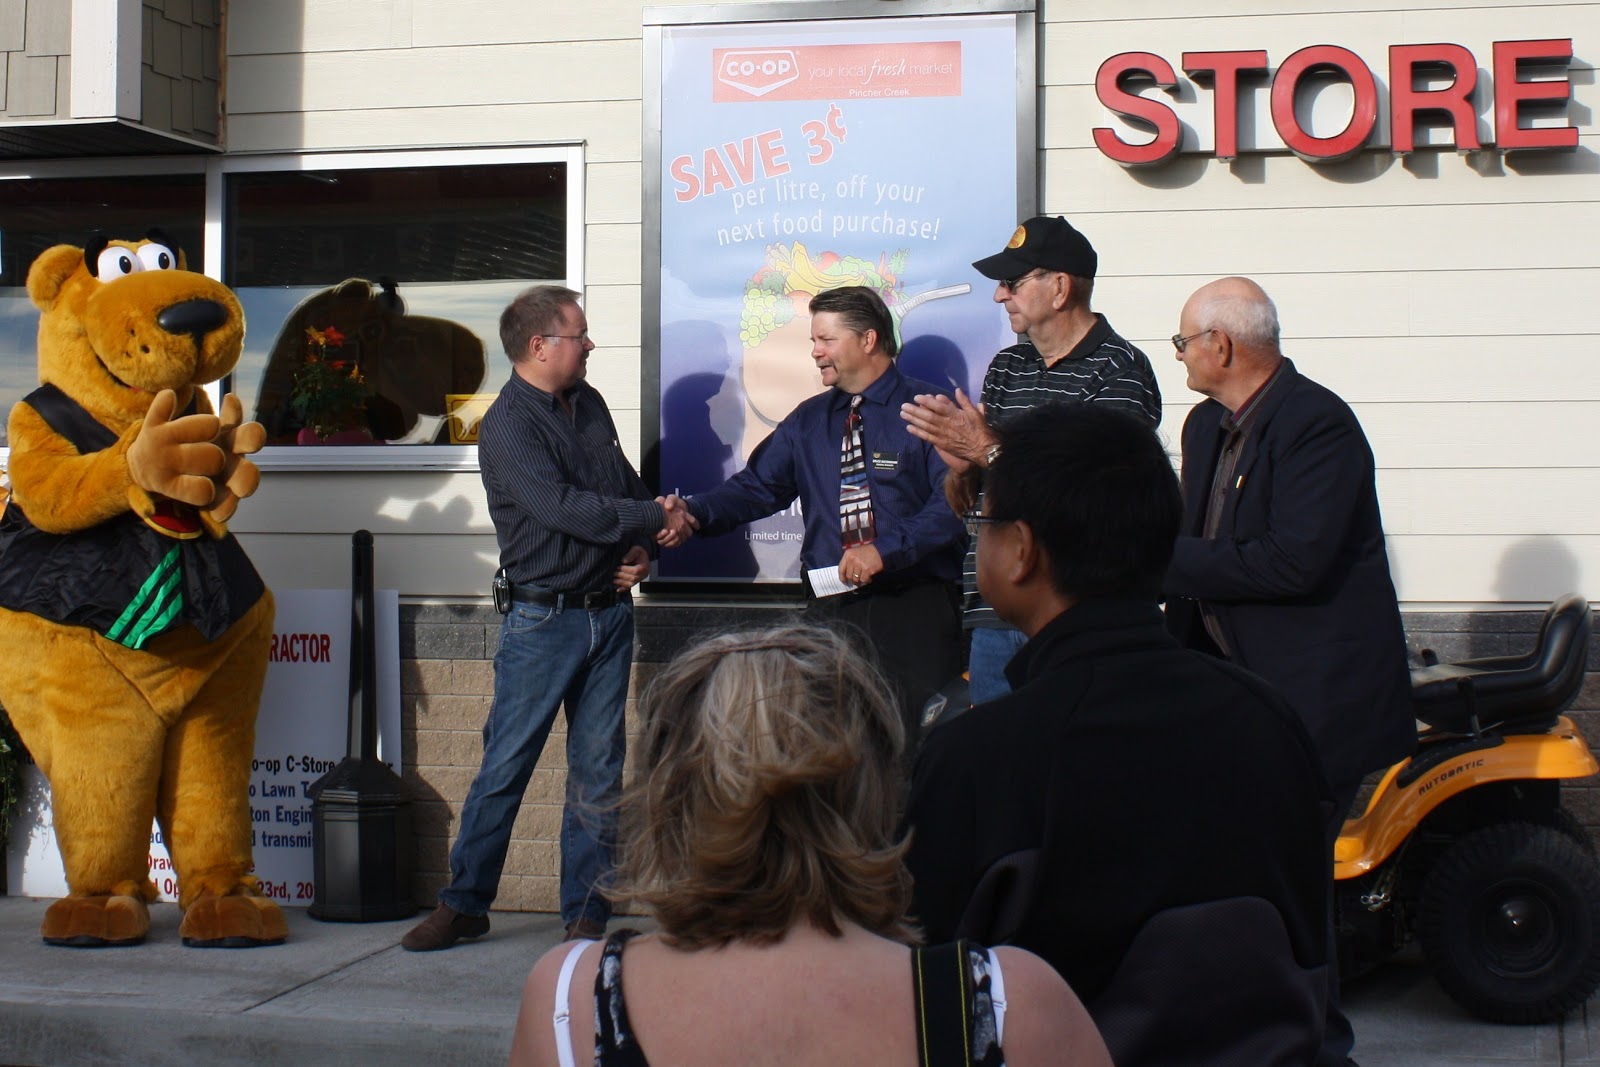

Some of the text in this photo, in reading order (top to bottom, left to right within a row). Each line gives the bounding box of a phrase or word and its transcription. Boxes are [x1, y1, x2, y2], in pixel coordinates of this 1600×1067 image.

[808, 58, 953, 84] your local fresh market
[849, 87, 910, 97] Pincher Creek
[1092, 38, 1579, 165] STORE
[670, 128, 792, 203] SAVE
[732, 174, 925, 214] per litre, off your
[717, 209, 941, 246] next food purchase!
[744, 530, 803, 541] Limited time
[269, 633, 331, 663] RACTOR
[252, 755, 335, 775] o-op C-Store
[1419, 759, 1485, 795] AUTOMATIC
[262, 780, 296, 797] Lawn
[275, 805, 313, 826] Engin
[262, 831, 313, 848] transmi
